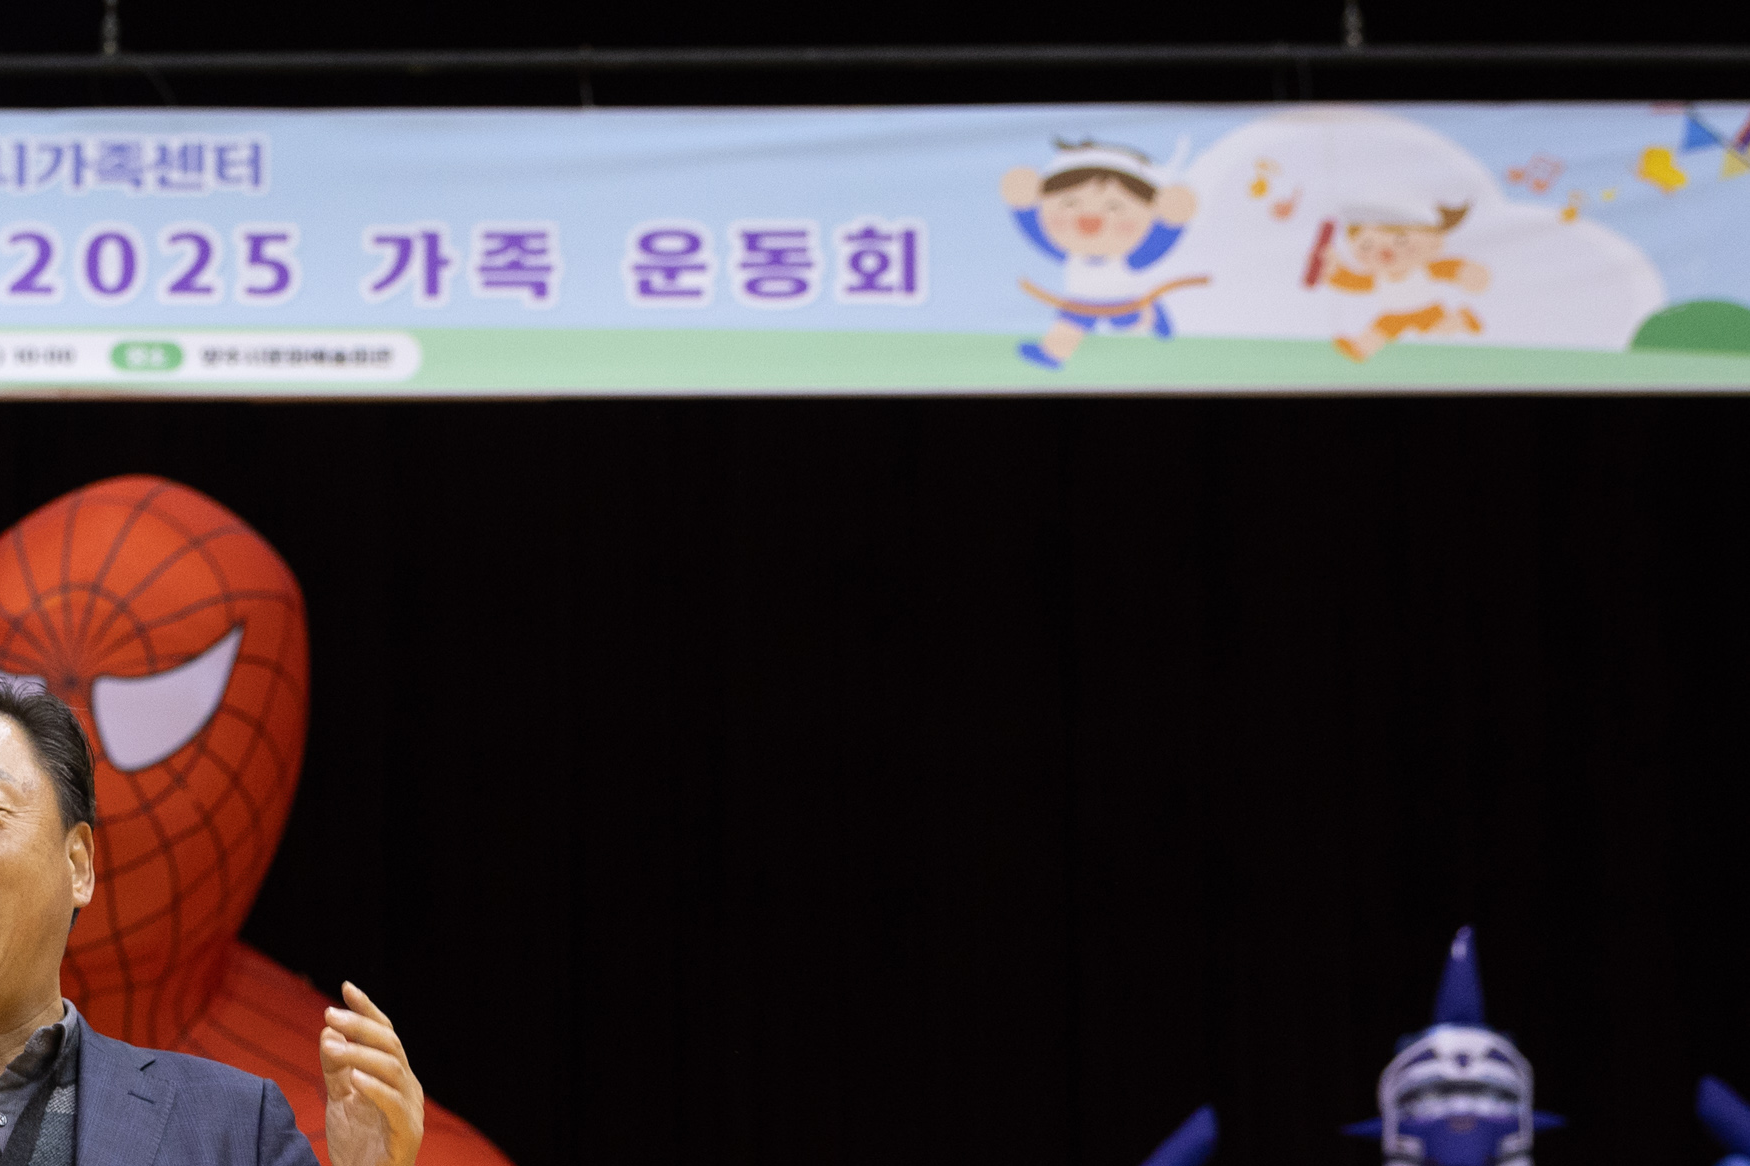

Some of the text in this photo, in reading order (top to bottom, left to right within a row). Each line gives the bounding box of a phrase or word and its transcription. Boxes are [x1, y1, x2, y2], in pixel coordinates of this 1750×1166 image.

[6, 230, 293, 297] 2025
[370, 230, 555, 302] 가족
[631, 226, 920, 299] 운동회
